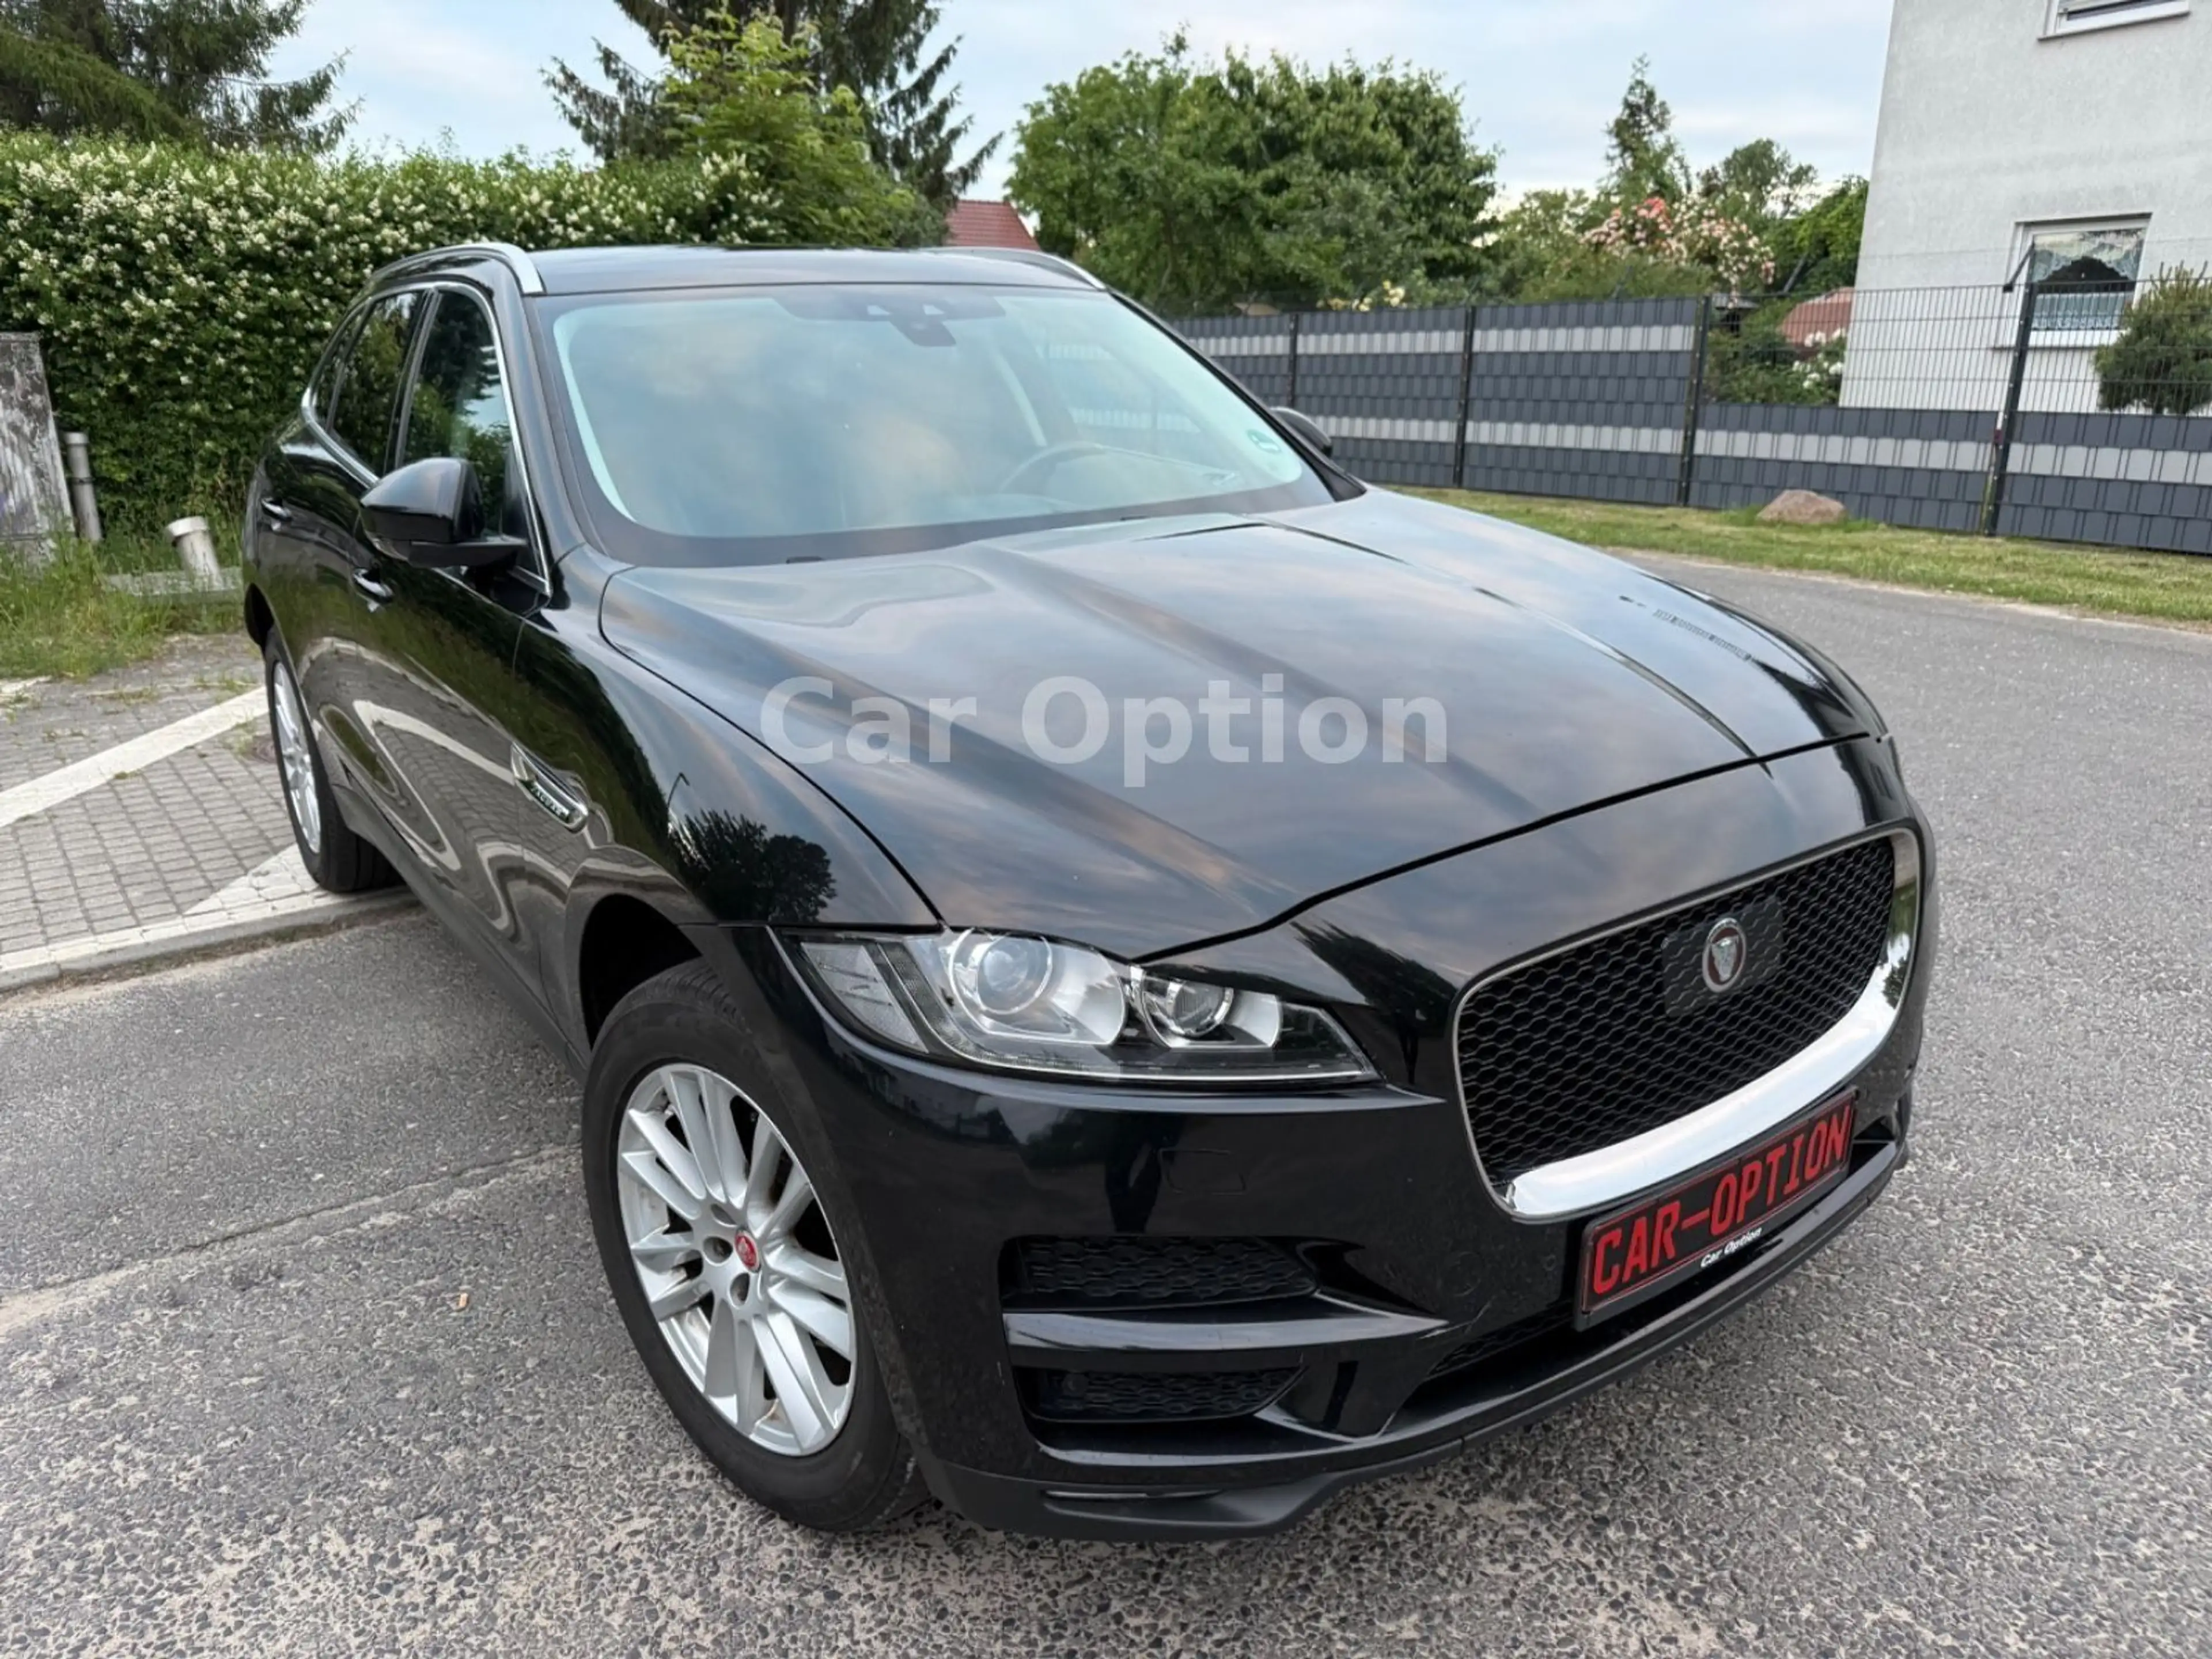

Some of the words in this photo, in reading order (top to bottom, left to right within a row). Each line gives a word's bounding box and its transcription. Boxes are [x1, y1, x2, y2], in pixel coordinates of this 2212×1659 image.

[1593, 1105, 1850, 1294] CAR-OPTION
[1700, 1249, 1723, 1268] Car
[1724, 1227, 1763, 1255] Option
